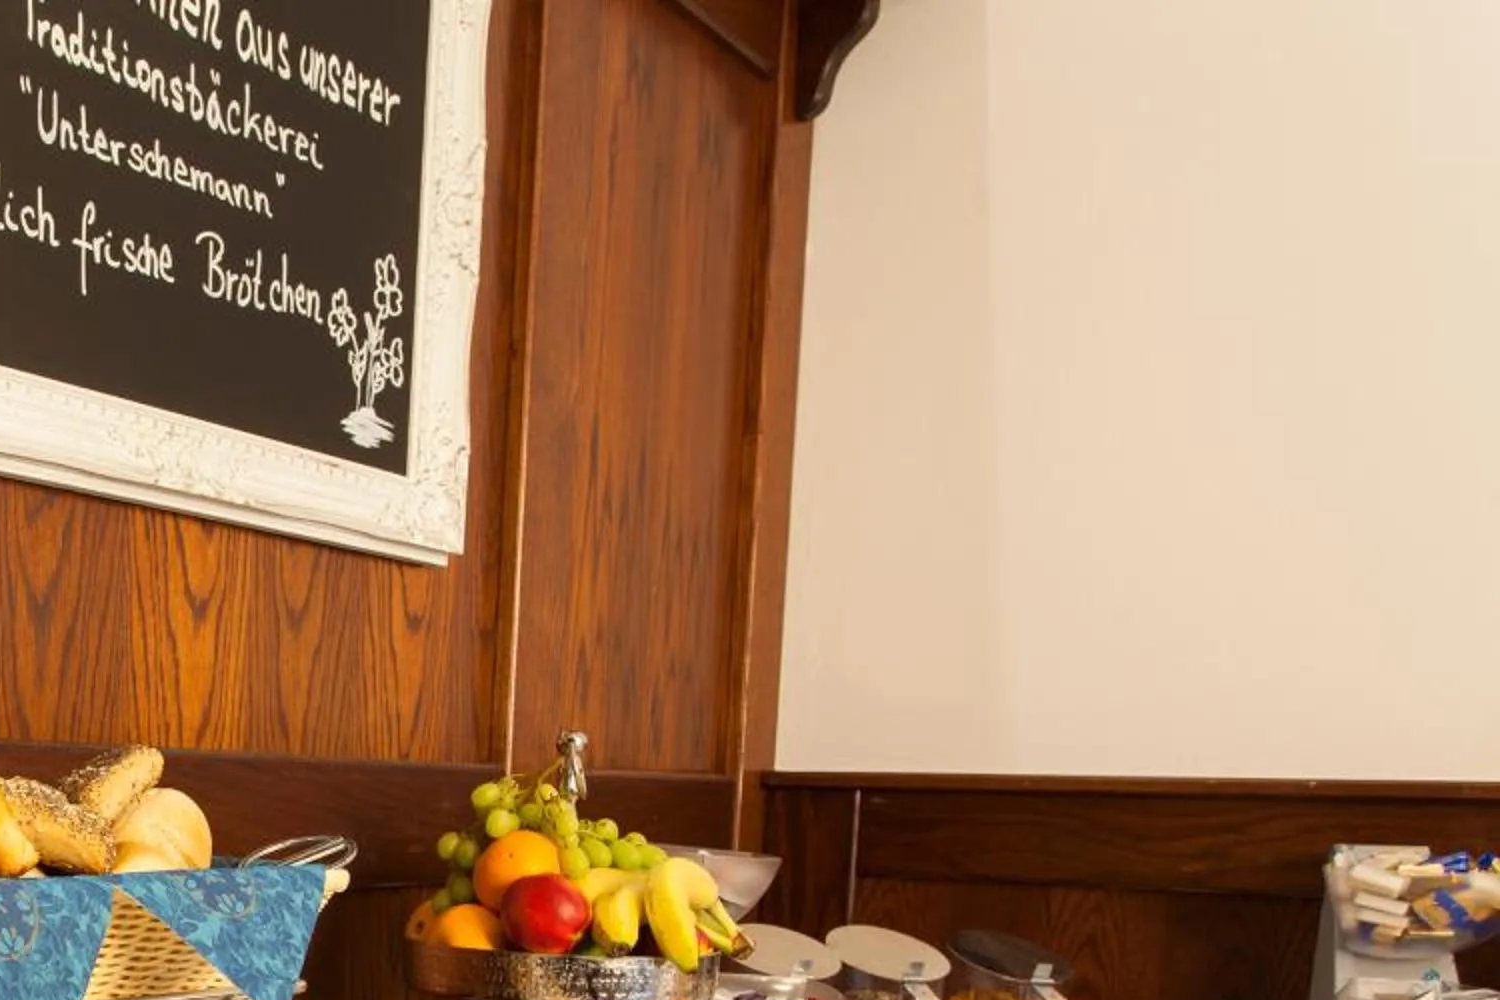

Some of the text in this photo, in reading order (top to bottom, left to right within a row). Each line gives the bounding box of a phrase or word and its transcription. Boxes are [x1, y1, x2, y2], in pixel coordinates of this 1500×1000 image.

[26, 0, 324, 171] Traditionsbäckerei
[235, 8, 292, 81] aus
[299, 44, 401, 126] unserer
[71, 200, 176, 297] frische
[194, 230, 324, 325] Brötchen
